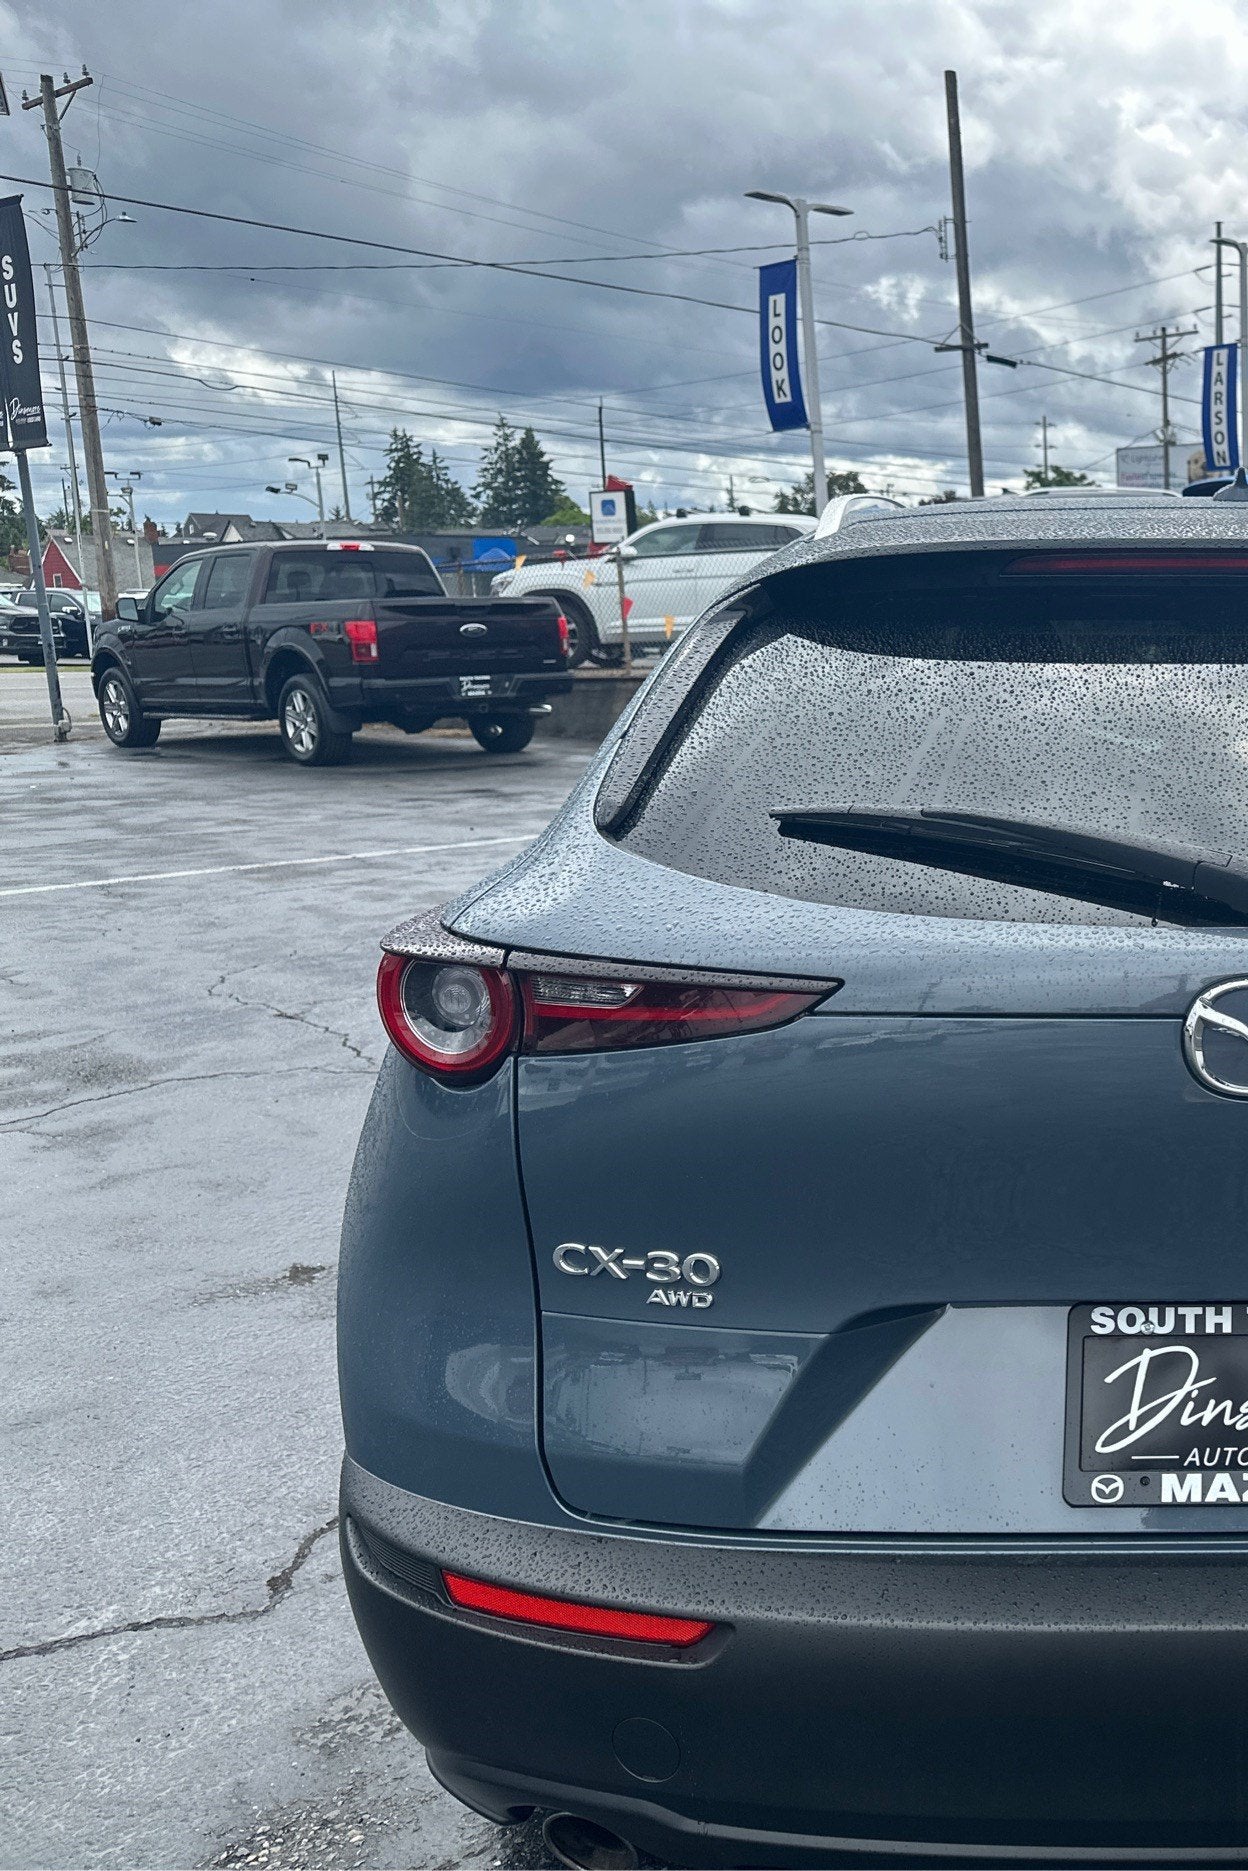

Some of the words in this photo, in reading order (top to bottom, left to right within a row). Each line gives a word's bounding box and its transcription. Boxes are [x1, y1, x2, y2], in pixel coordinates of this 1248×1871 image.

[1, 255, 23, 365] SUVS
[771, 299, 787, 399] LOOK
[1214, 352, 1227, 465] LARSON
[552, 1242, 721, 1287] CX-30
[646, 1289, 714, 1309] AWD
[1090, 1306, 1232, 1335] SOUTH
